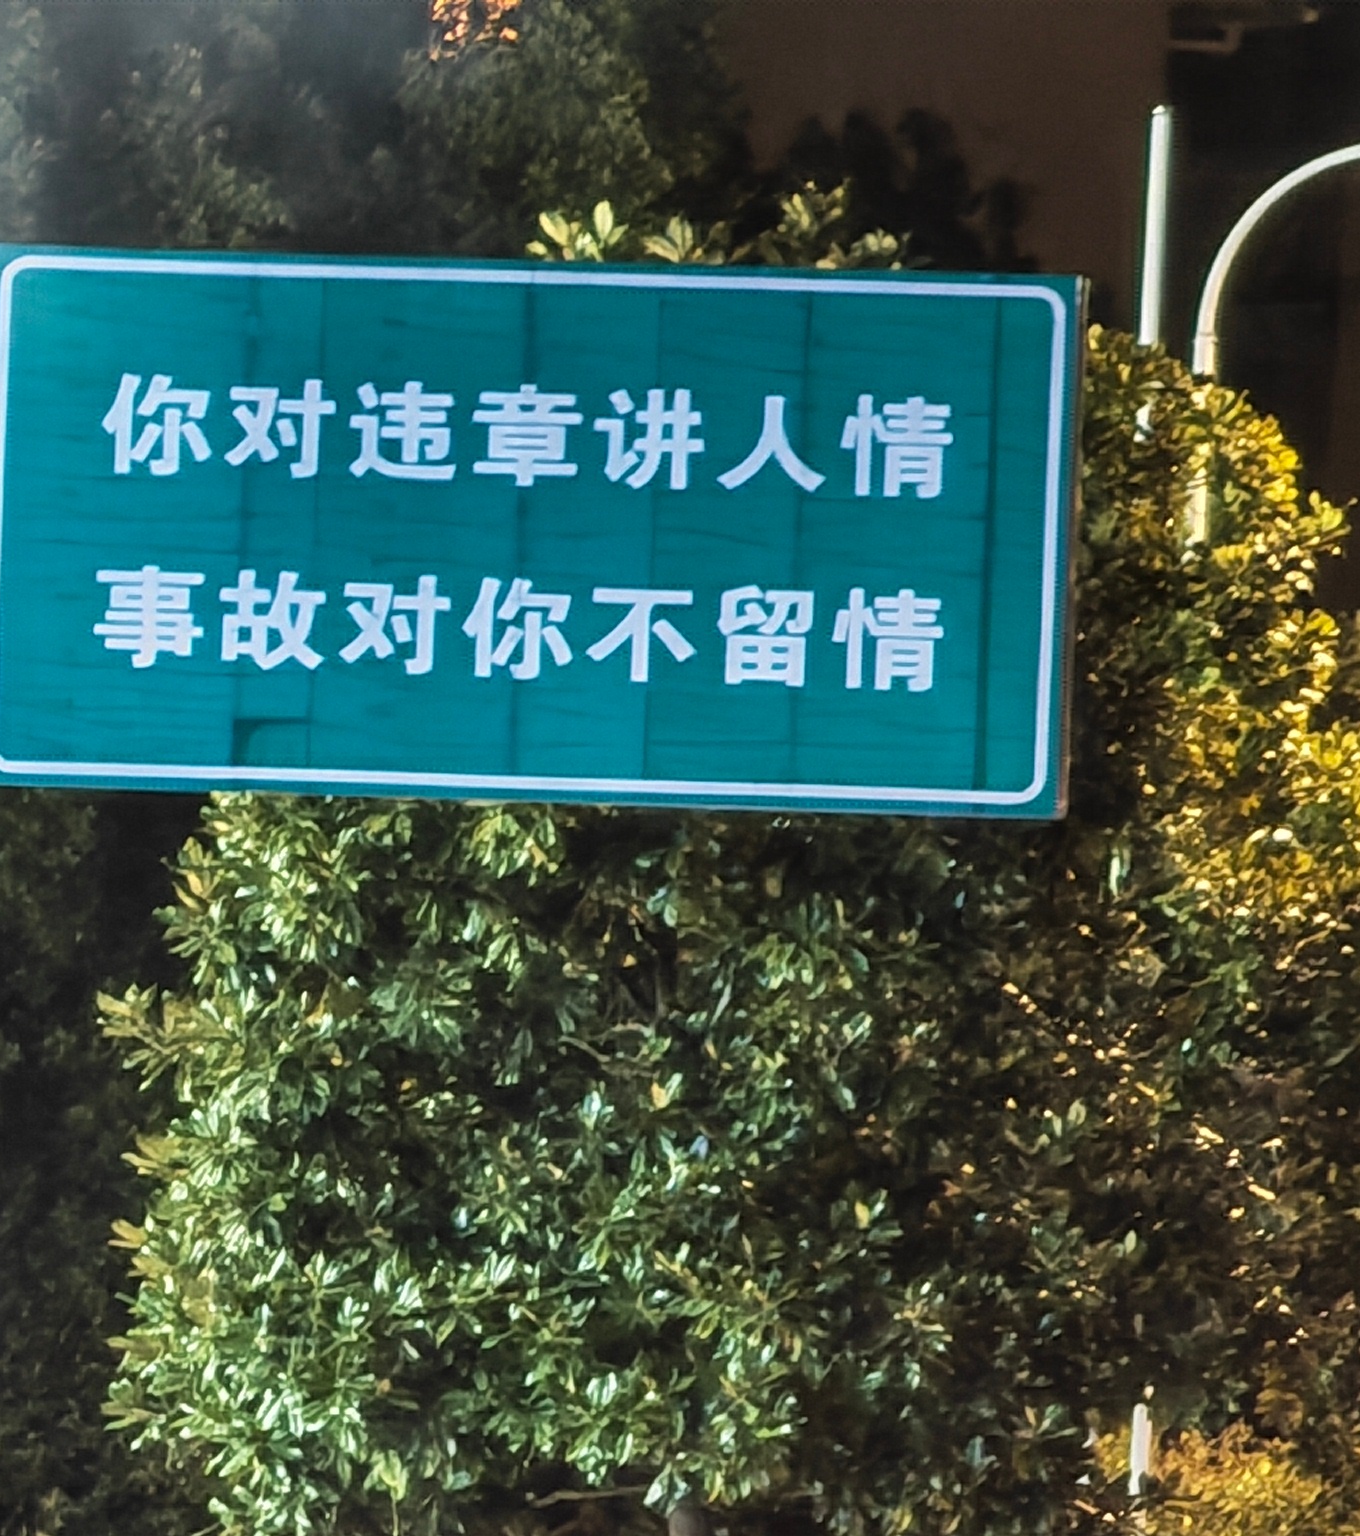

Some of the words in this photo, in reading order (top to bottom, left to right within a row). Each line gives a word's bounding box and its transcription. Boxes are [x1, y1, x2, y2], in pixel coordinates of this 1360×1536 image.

[102, 373, 953, 498] 你对违章讲人情
[93, 565, 944, 692] 事故对你不留情
